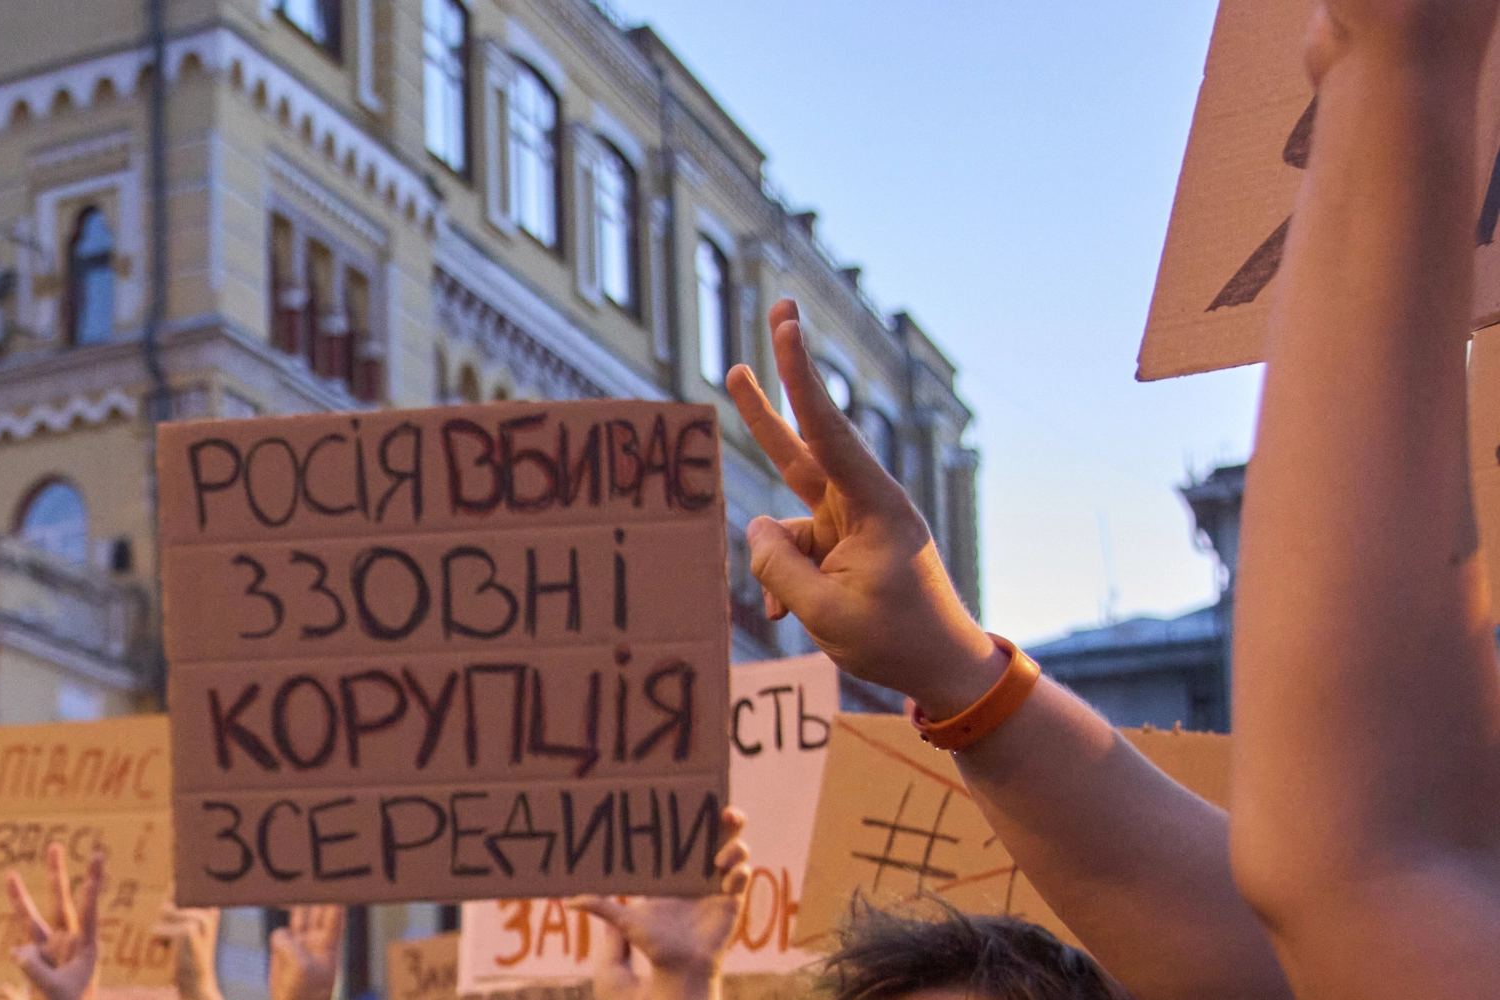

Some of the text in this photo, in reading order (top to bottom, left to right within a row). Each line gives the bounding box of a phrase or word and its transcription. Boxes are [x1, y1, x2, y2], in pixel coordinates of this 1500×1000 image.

[187, 411, 717, 532] РОСІЯ ВБИВАЄ
[230, 528, 628, 642] ЗЗОВНІ
[207, 645, 696, 779] КОРУПЦІЯ
[201, 788, 720, 885] ЗСЕРЕДИНИ
